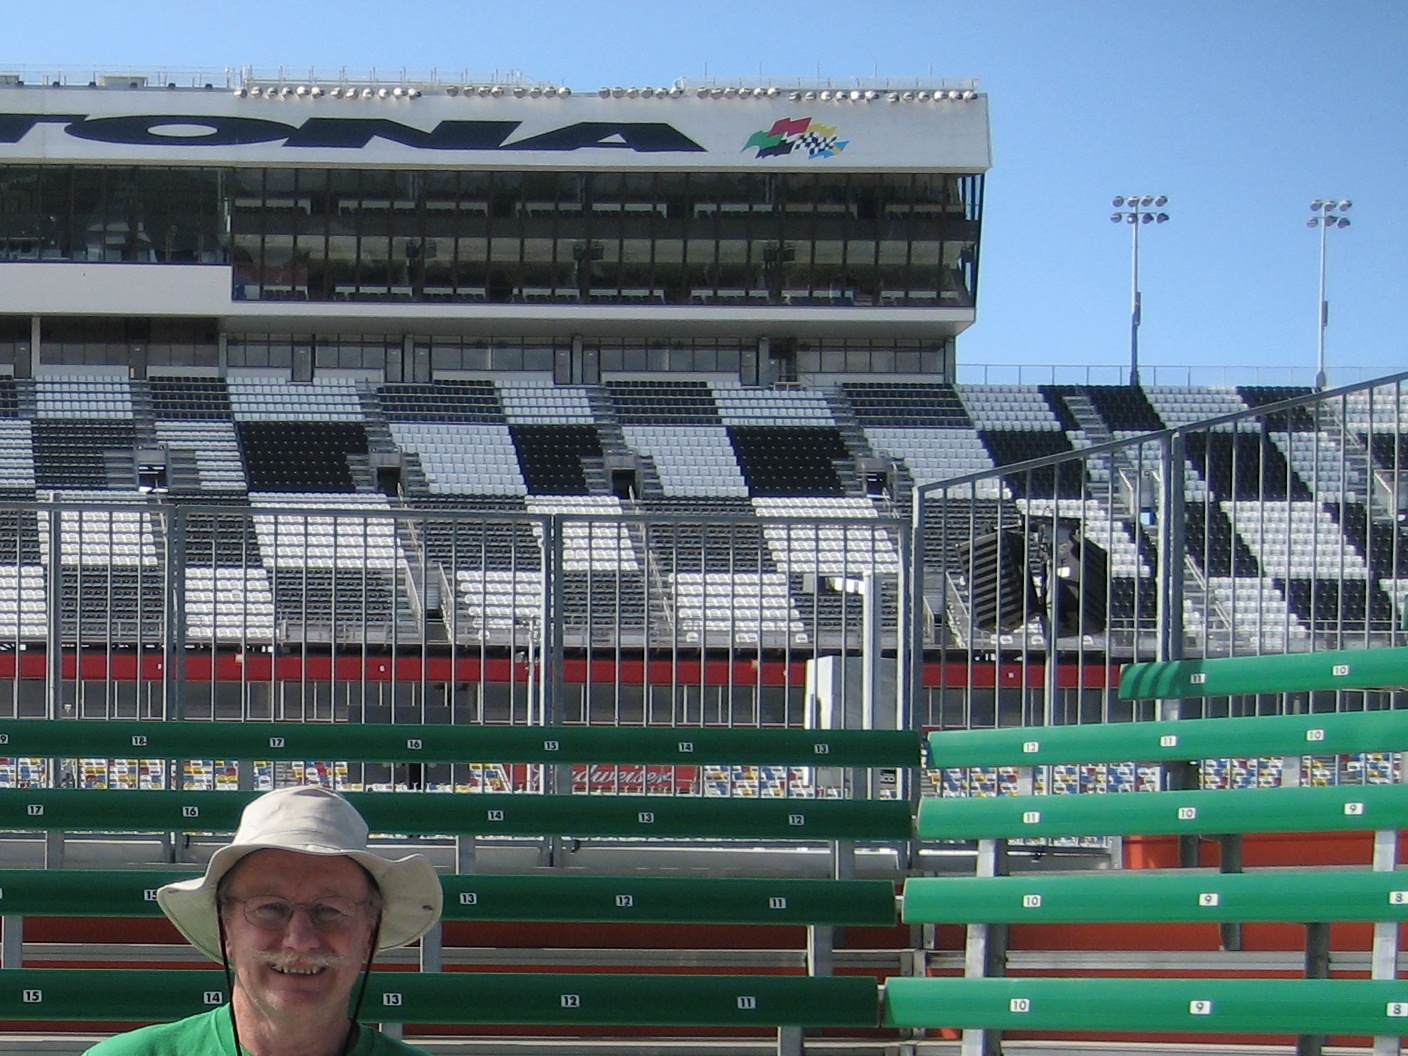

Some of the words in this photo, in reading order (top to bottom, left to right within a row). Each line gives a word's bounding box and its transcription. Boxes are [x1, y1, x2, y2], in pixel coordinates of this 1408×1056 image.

[1336, 666, 1347, 675] 10
[1309, 730, 1322, 740] 10
[271, 738, 283, 747] 17
[409, 740, 420, 749] 16
[1163, 736, 1172, 745] 11
[546, 741, 557, 750] 15
[30, 805, 42, 815] 17
[185, 807, 197, 816] 16
[1181, 808, 1194, 818] 10
[490, 811, 502, 820] 14
[640, 813, 652, 822] 13
[1026, 813, 1036, 822] 11
[791, 816, 802, 825] 12
[462, 894, 475, 903] 13
[618, 896, 631, 905] 12
[1026, 896, 1039, 906] 10
[772, 899, 783, 908] 11
[26, 991, 40, 1001] 15
[206, 993, 220, 1002] 14
[385, 995, 400, 1004] 13
[563, 996, 578, 1006] 12
[740, 998, 752, 1007] 11
[1013, 1000, 1027, 1010] 10
